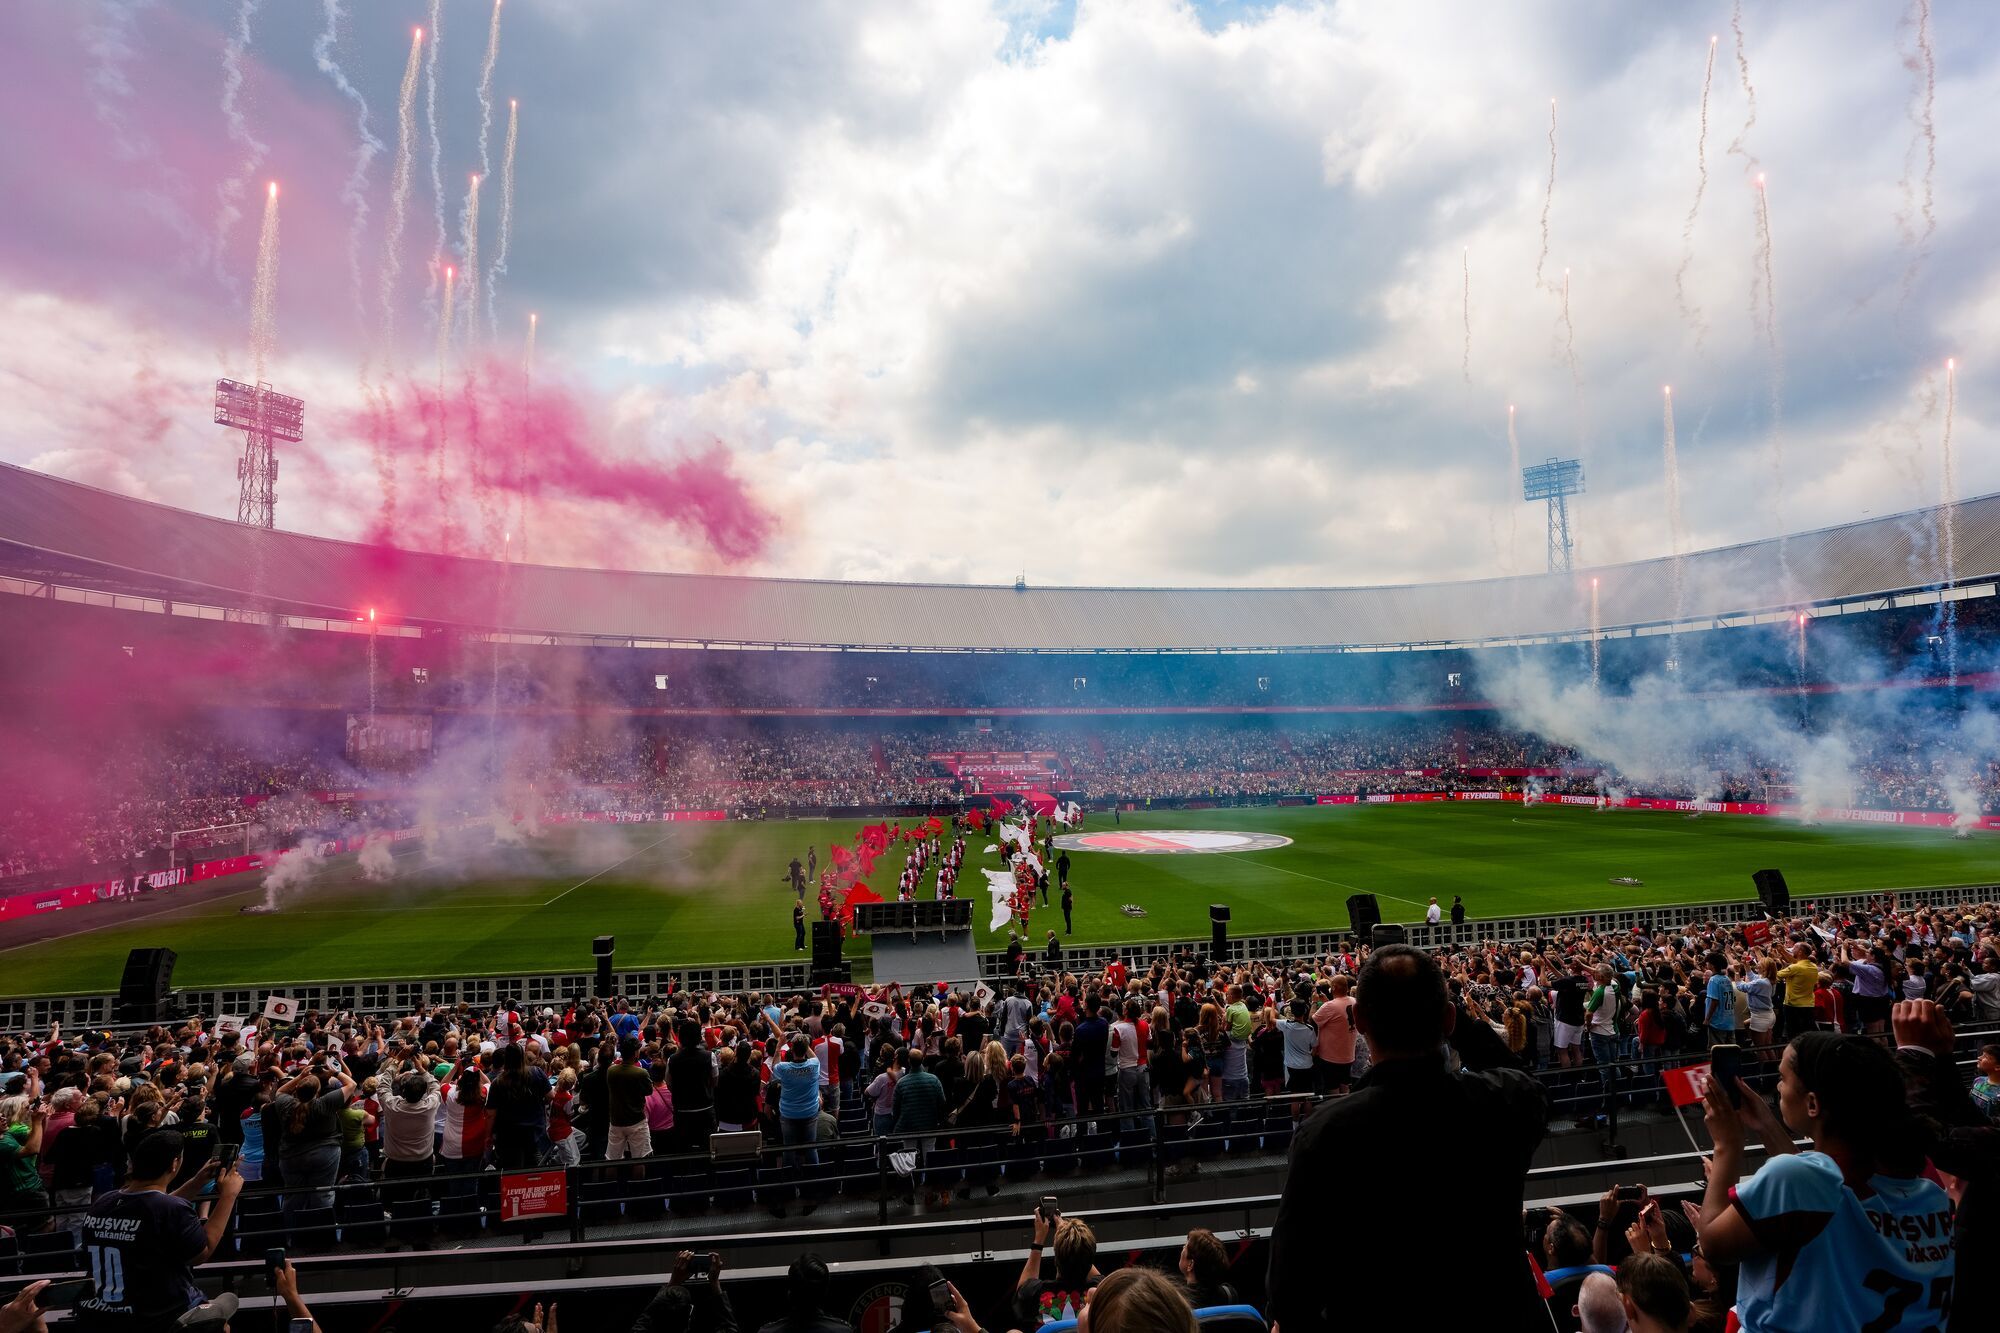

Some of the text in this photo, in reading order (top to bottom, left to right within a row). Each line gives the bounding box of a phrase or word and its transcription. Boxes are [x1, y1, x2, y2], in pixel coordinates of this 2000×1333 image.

[1354, 795, 1390, 803] FENOORD
[1462, 792, 1499, 800] FEYENOORD
[1561, 795, 1595, 805] FEYENOORD
[1722, 803, 1727, 812] 1
[83, 1214, 141, 1232] PRIJSVRIJ
[94, 1230, 136, 1242] vakanties
[87, 1245, 125, 1302] 10
[855, 1285, 908, 1314] FEYENO
